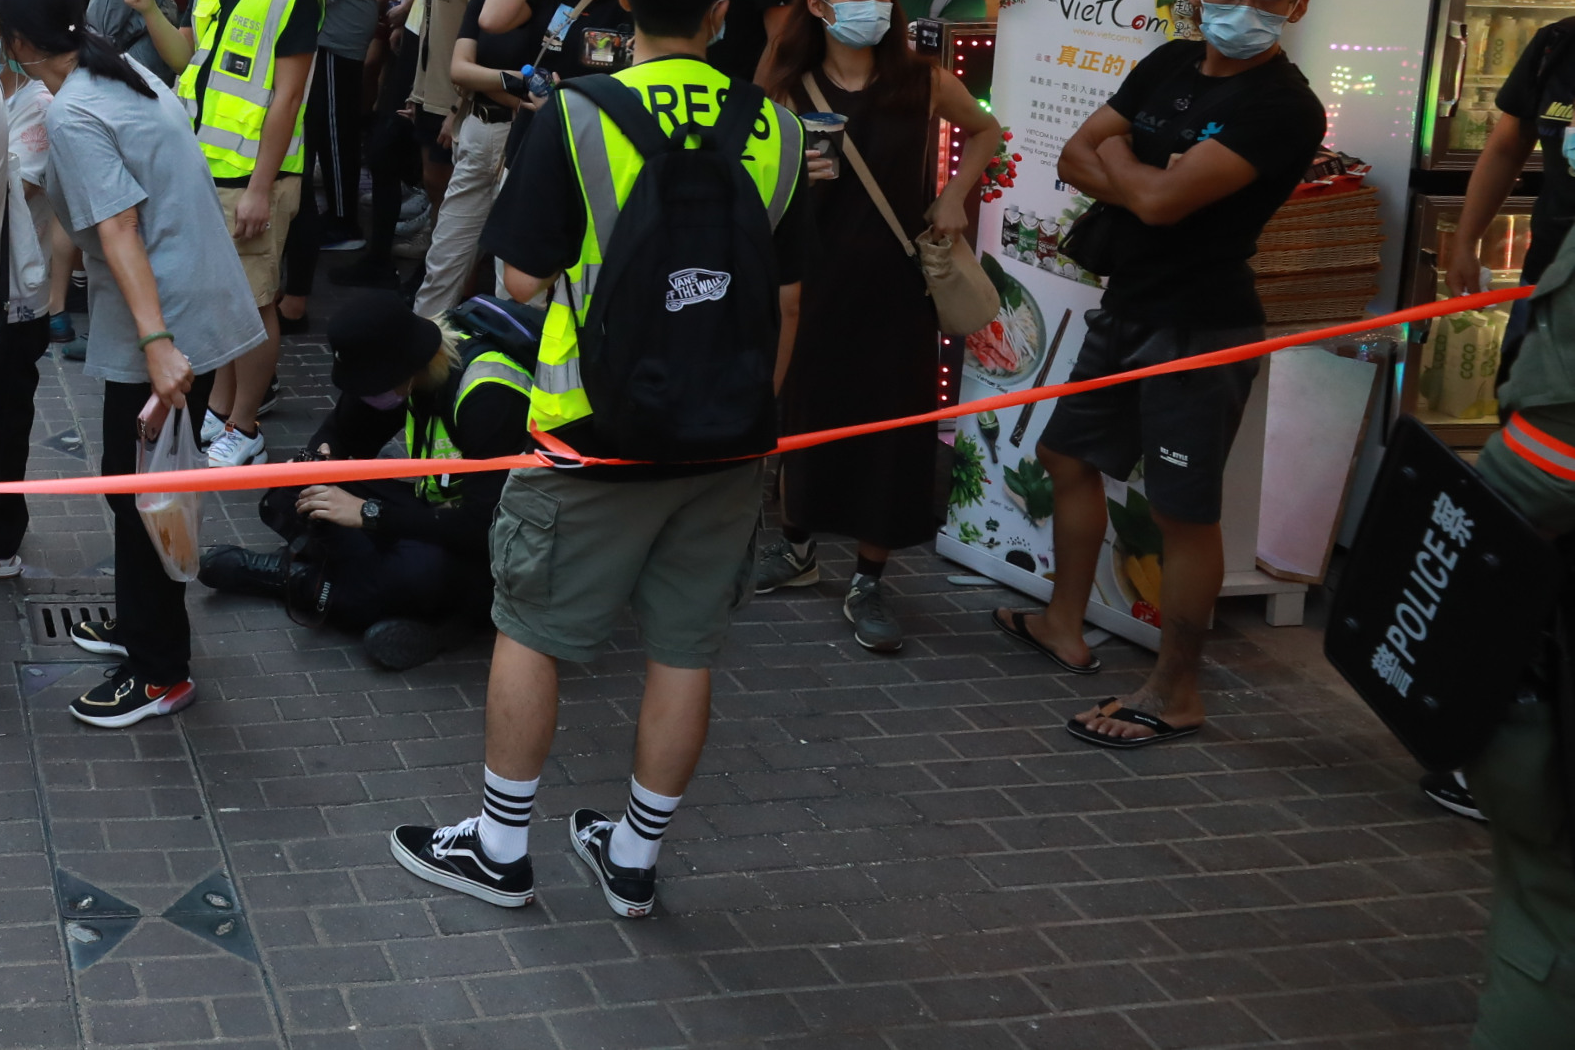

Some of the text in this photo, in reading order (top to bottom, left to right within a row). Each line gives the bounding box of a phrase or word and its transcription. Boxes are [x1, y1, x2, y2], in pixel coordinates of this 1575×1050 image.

[233, 14, 261, 31] PRESS
[230, 27, 256, 47] 記者
[669, 274, 698, 291] VANS
[1460, 343, 1476, 380] COCO
[316, 581, 332, 612] Canon
